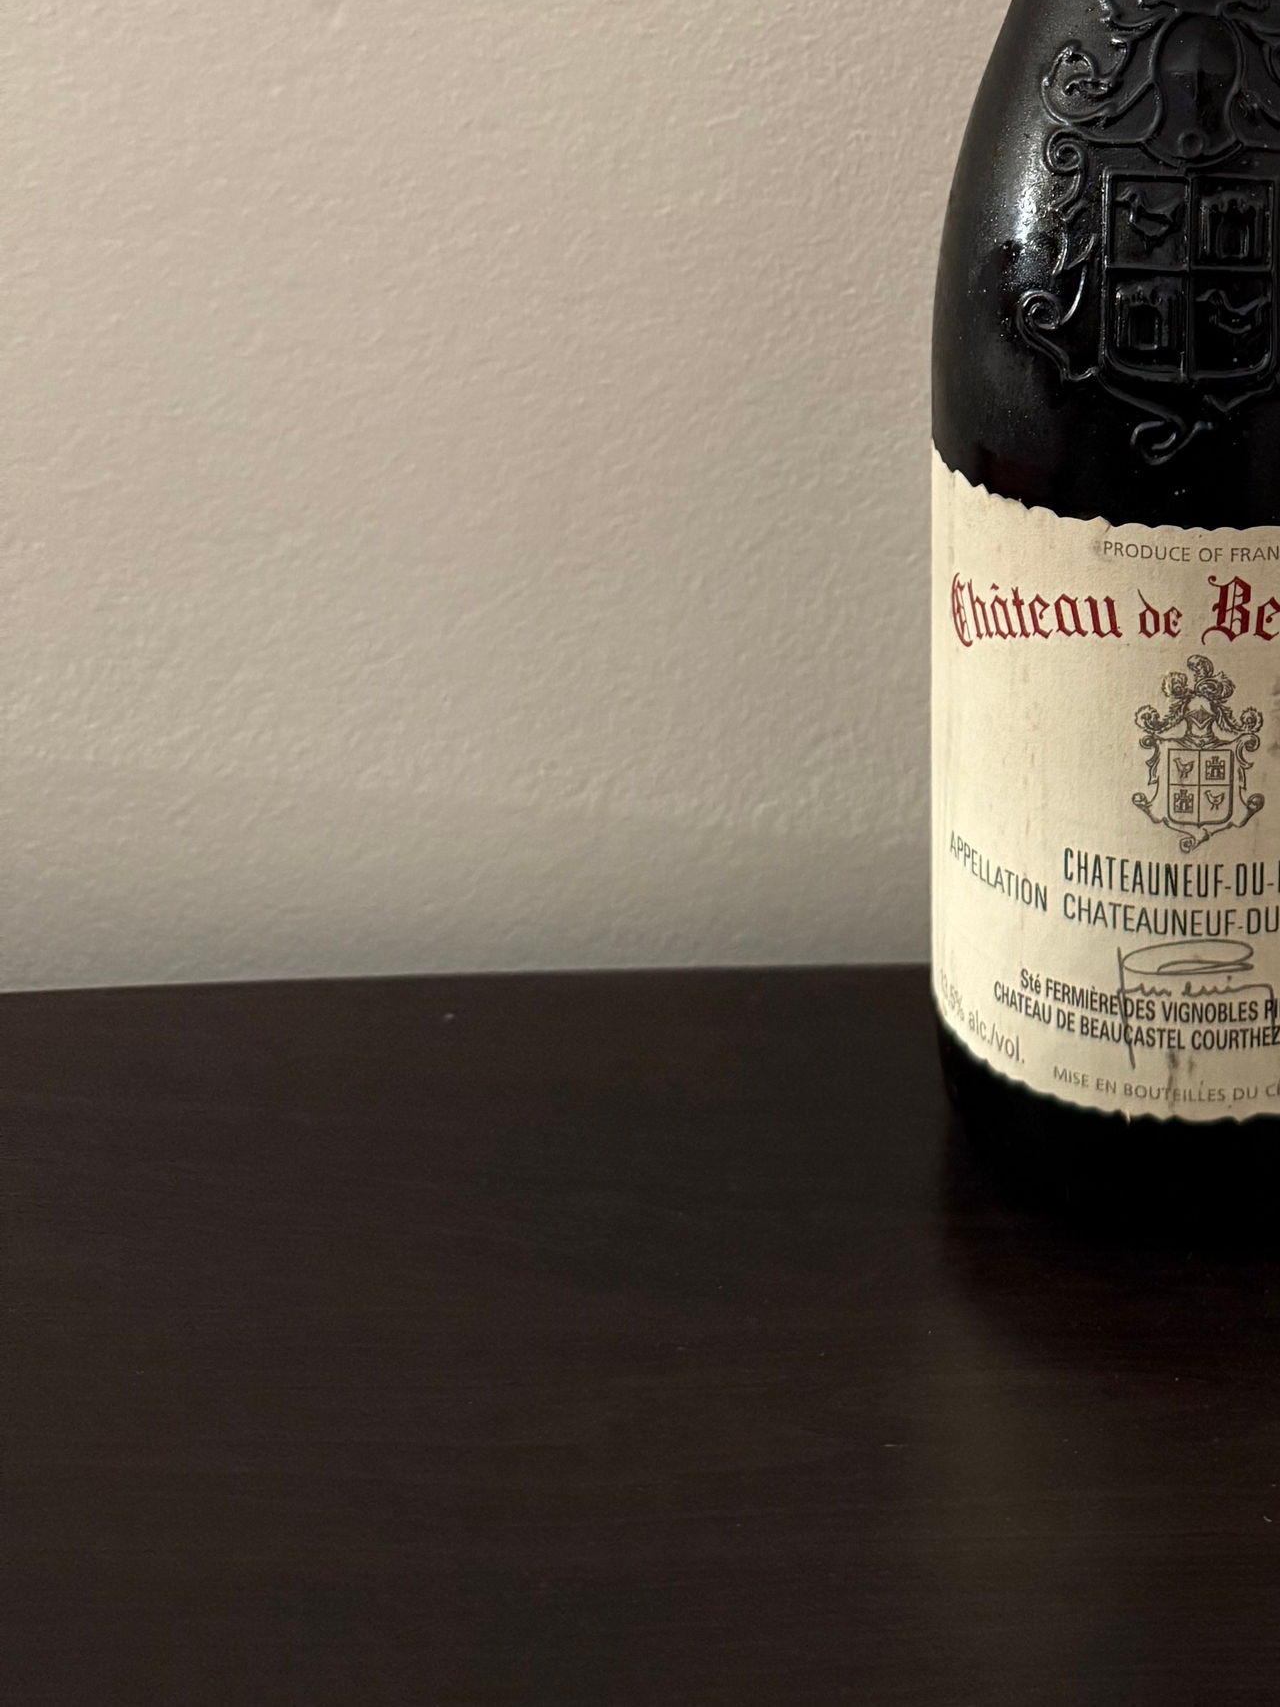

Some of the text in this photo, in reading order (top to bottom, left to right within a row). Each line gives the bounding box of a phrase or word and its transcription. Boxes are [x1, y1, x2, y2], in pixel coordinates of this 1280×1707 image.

[1103, 540, 1191, 562] PRODUCE
[1198, 547, 1224, 563] OF
[951, 572, 1123, 648] Château
[1138, 588, 1183, 639] de
[949, 829, 1048, 913] APPELLATION
[993, 980, 1052, 1025] CHATEAU
[1056, 1007, 1076, 1033] DE
[1079, 1014, 1186, 1050] BEAUCASTEL
[1020, 968, 1042, 995] Sté
[1045, 977, 1119, 1016] FERMIÈRE
[1124, 997, 1156, 1021] DES
[1161, 1001, 1258, 1024] VIGNOBLES
[1053, 1065, 1090, 1089] MISE
[1096, 1077, 1117, 1095] EN
[1123, 1082, 1226, 1102] BOUTEILLES
[1232, 1087, 1259, 1102] DU
